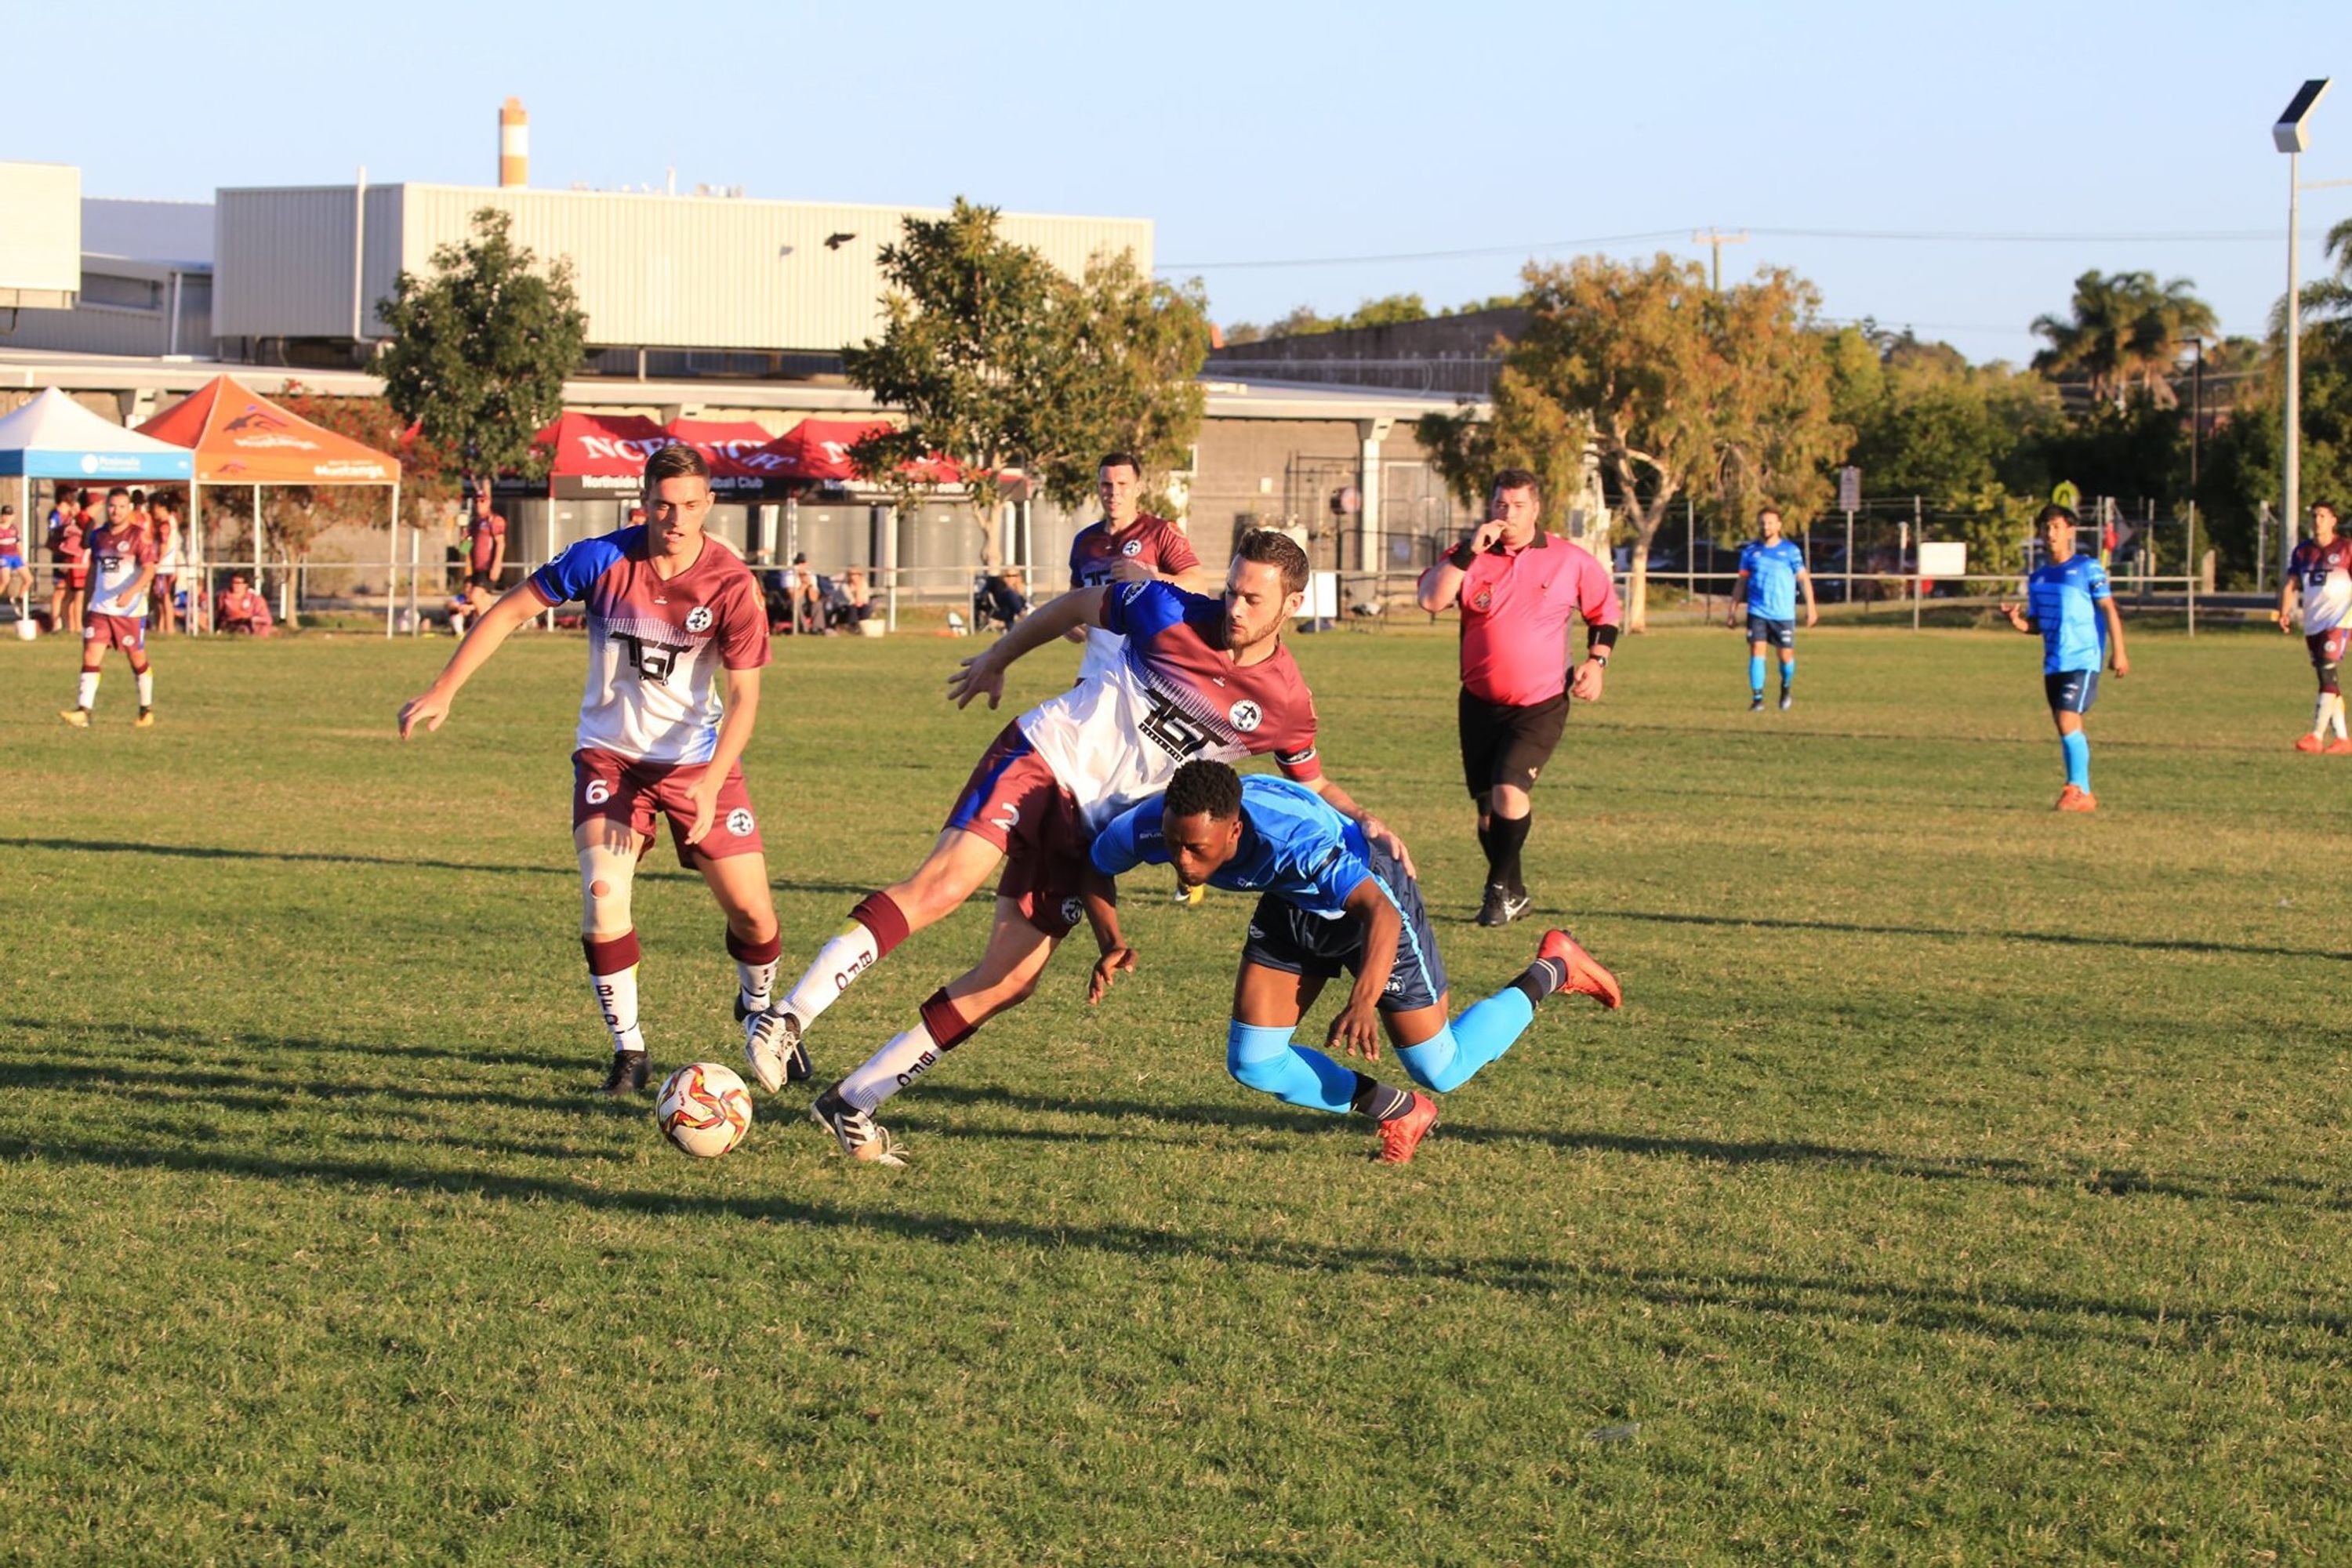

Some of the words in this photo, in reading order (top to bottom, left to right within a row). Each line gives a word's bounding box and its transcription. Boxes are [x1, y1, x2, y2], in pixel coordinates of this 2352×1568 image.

[581, 474, 638, 488] Northside
[585, 779, 610, 805] 6
[990, 801, 1020, 833] 2
